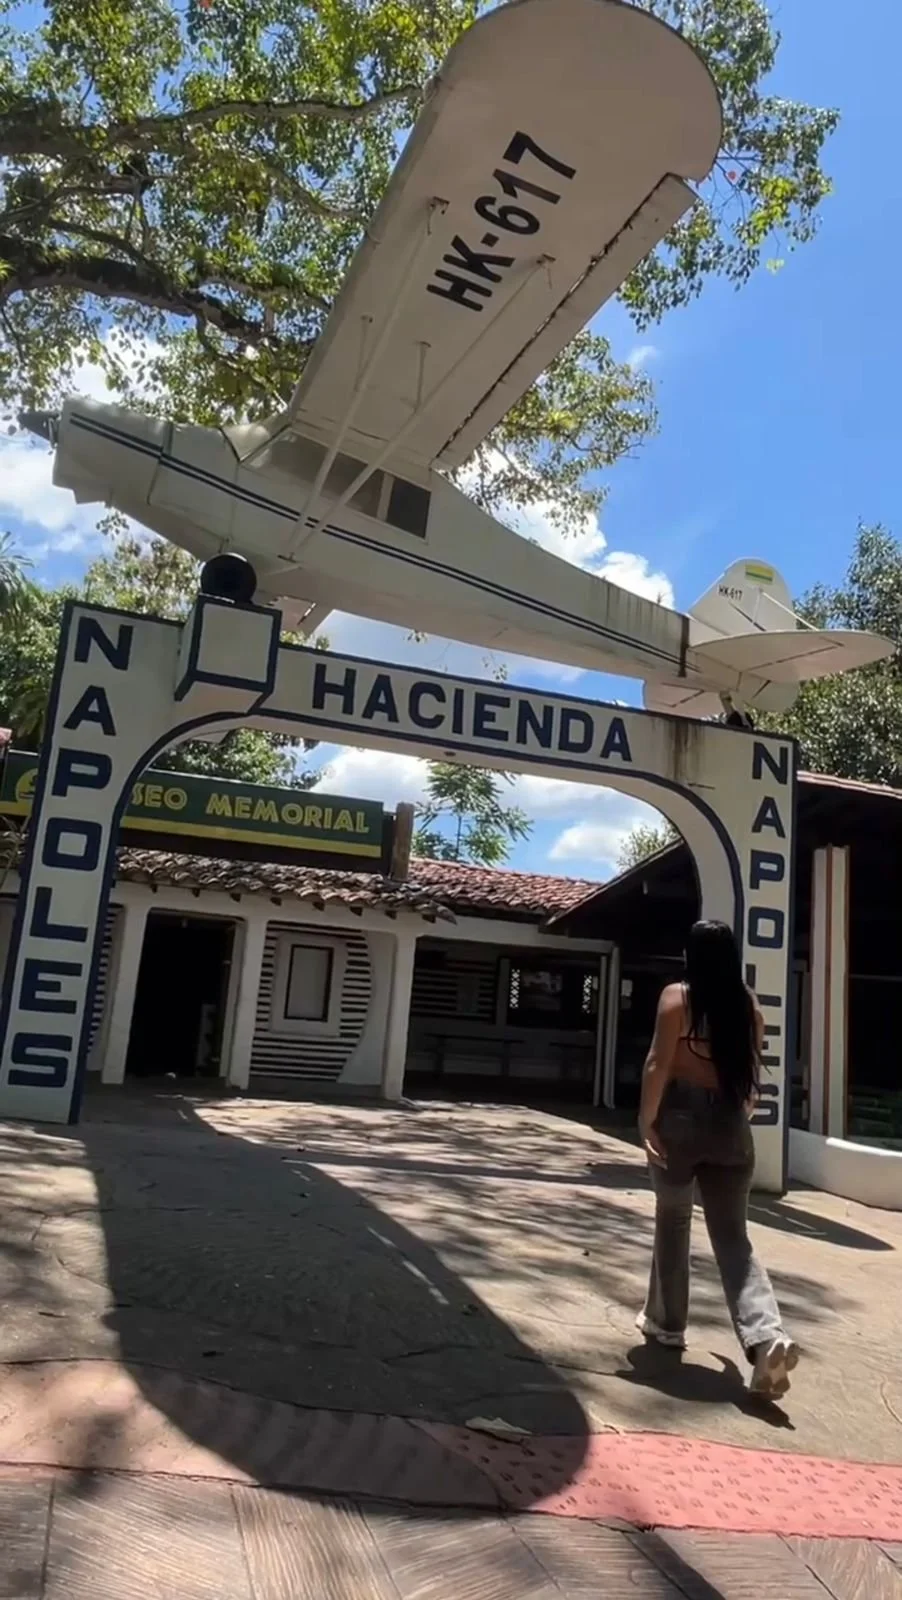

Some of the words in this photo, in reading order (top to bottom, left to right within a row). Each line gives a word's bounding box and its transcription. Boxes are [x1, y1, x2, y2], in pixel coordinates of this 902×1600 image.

[426, 130, 576, 312] HK-617
[311, 662, 633, 763] HACIENDA
[7, 616, 134, 1088] NAPOLES
[131, 782, 188, 810] SEO
[205, 792, 370, 834] MEMORIAL
